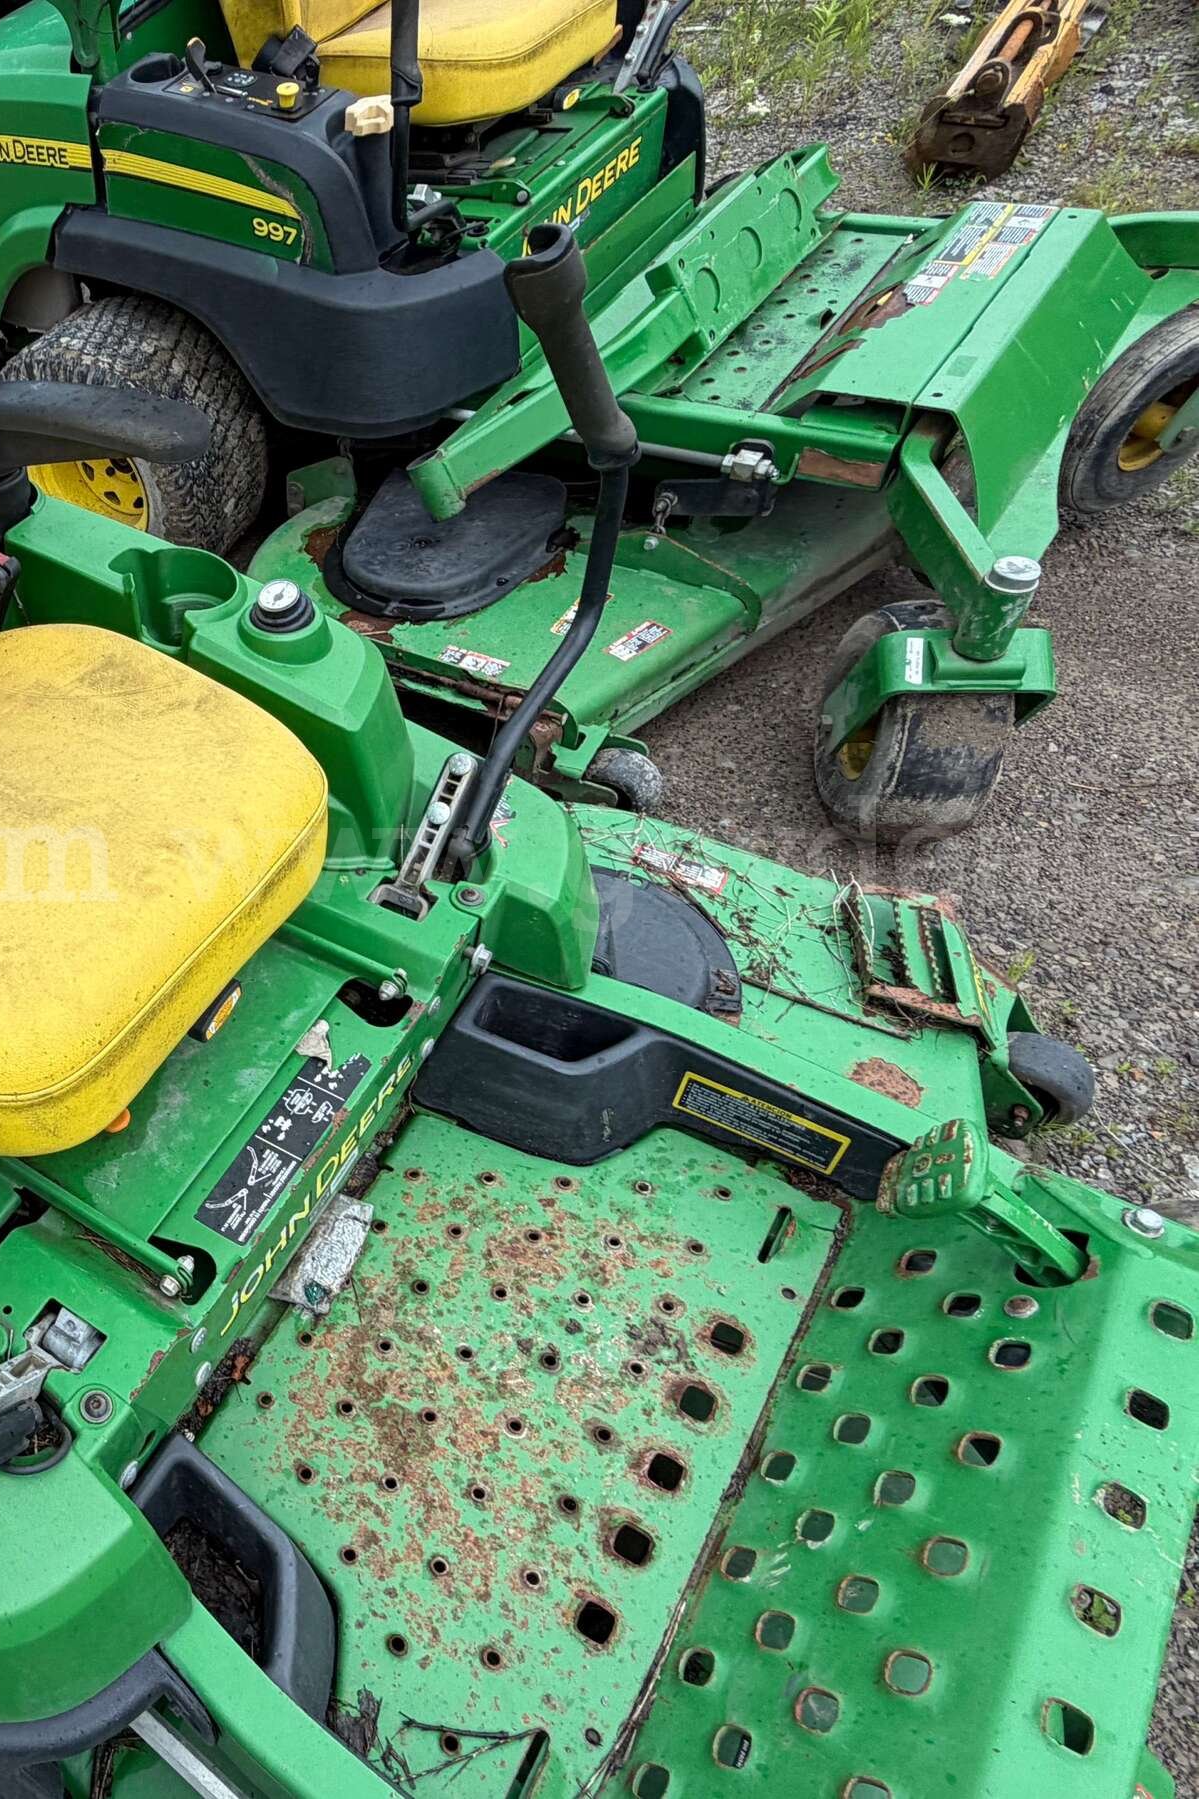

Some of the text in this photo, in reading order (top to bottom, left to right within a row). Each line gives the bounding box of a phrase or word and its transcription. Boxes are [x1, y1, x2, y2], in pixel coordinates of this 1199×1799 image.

[13, 139, 69, 165] DEERE
[575, 136, 642, 216] DEERE
[252, 217, 298, 245] 997
[220, 1193, 311, 1336] JOHN
[316, 1055, 413, 1200] DEERE
